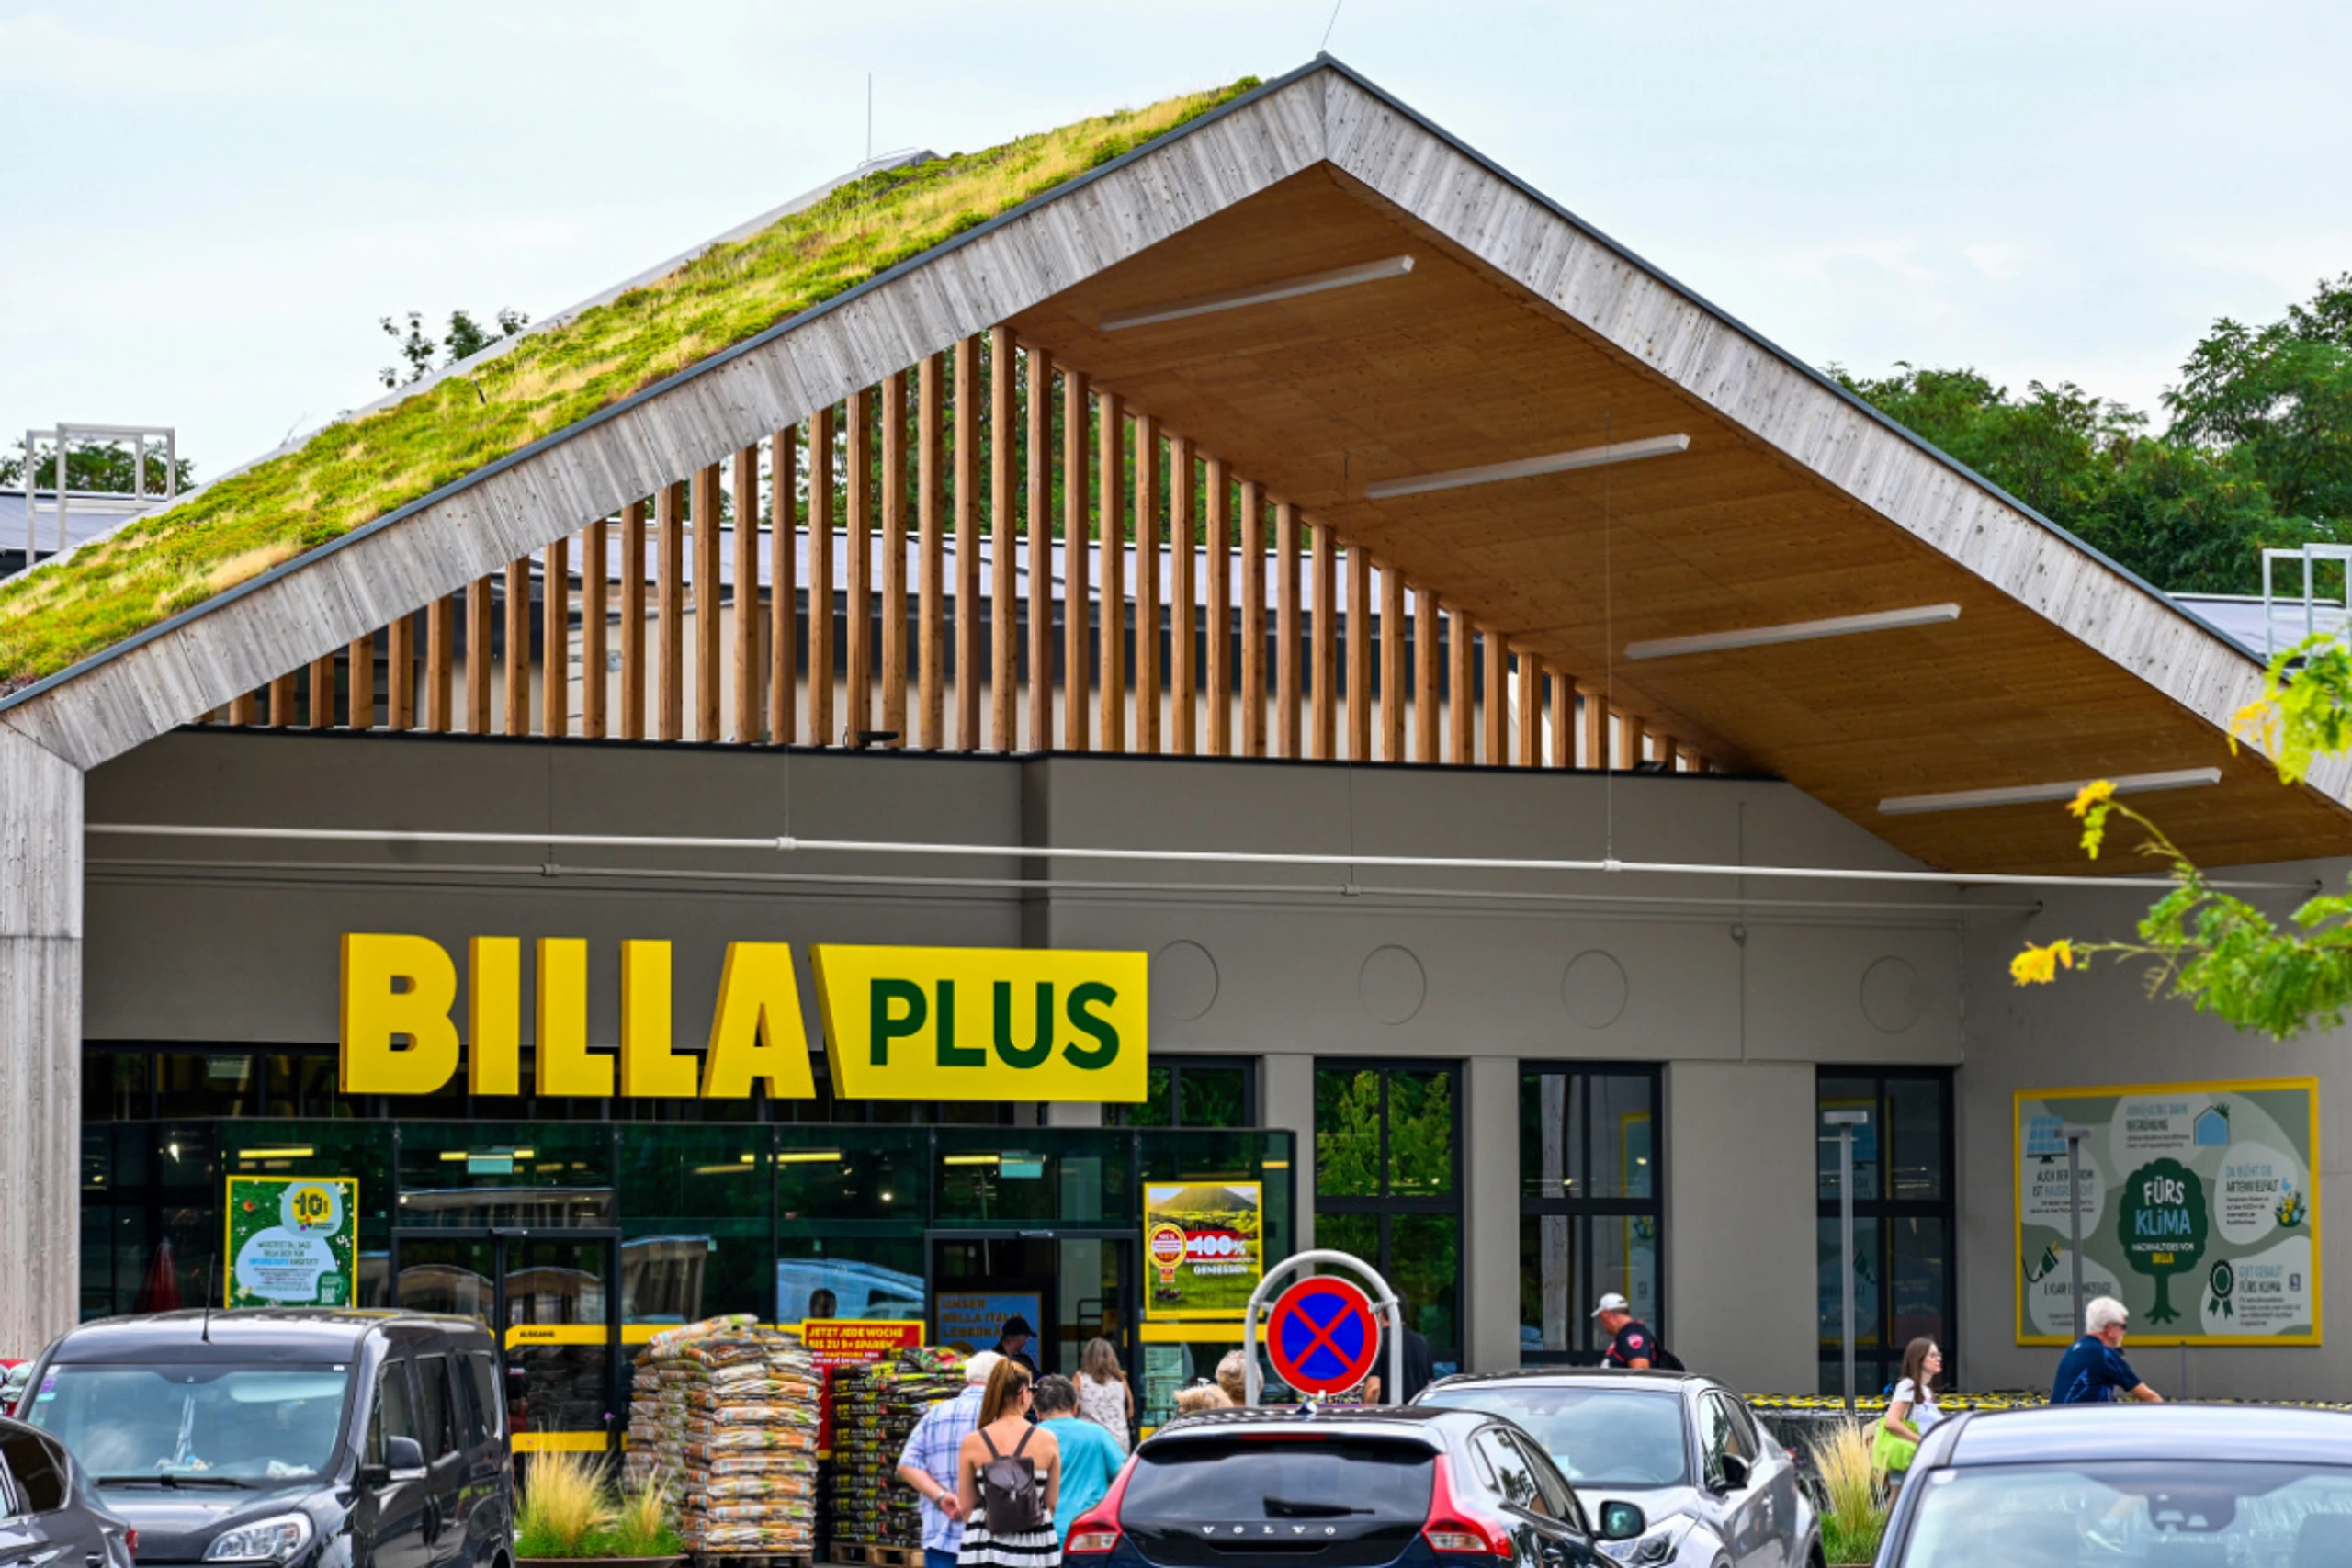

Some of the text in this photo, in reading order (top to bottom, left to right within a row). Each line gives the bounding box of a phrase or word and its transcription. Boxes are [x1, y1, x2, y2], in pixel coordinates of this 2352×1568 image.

[339, 932, 1120, 1100] BILLA PLUS
[2143, 1175, 2186, 1206] FÜRS
[293, 1191, 322, 1216] 10
[1193, 1235, 1246, 1256] 100%
[943, 1298, 985, 1309] UNSER
[943, 1313, 981, 1323] BELLA
[809, 1327, 903, 1337] JETZT JEDE WOCHE
[943, 1324, 1001, 1337] LEBERKÄ
[827, 1340, 840, 1349] ZU
[1202, 1526, 1337, 1535] VOLVO
